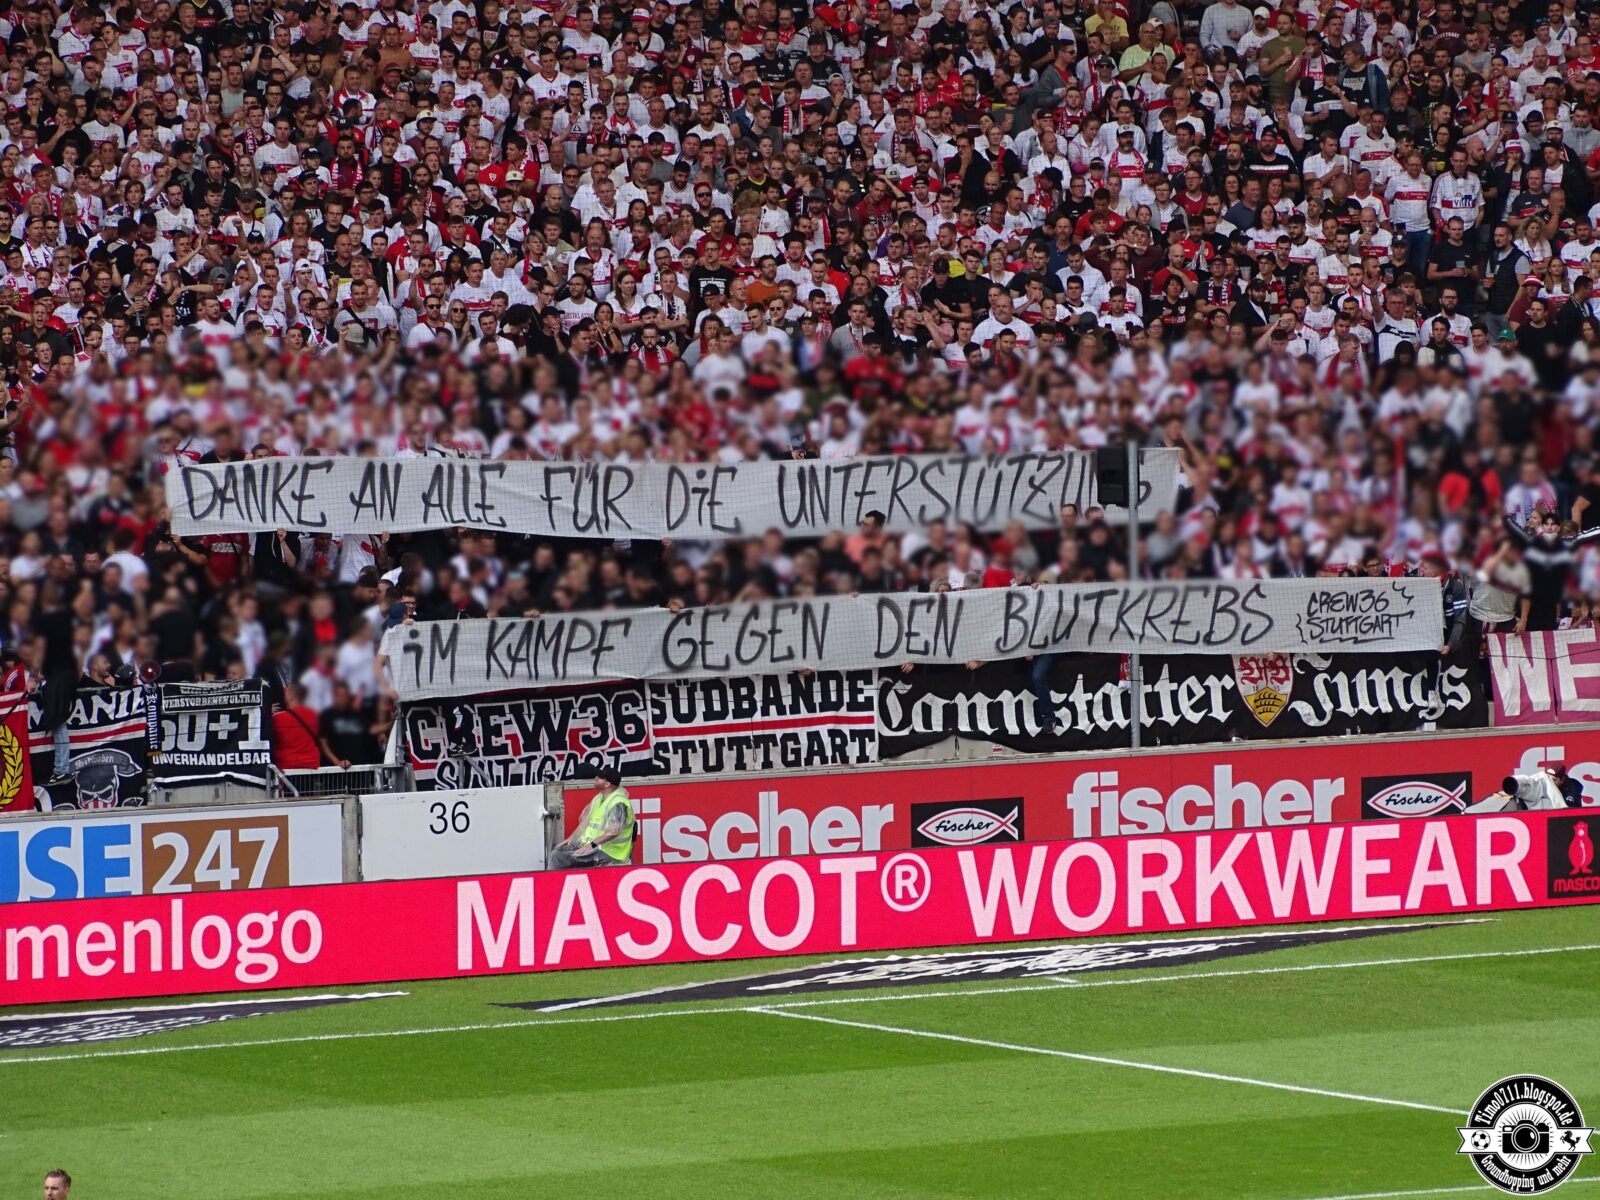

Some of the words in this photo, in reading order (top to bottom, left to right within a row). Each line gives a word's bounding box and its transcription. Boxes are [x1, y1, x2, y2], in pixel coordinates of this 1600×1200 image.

[182, 459, 335, 528] DANKE
[349, 461, 403, 524] AN
[421, 462, 507, 528] ALLE
[539, 462, 634, 533] FÜR
[777, 449, 1152, 530] UNTERSTÜTZUN
[485, 617, 634, 681] KAMPF
[661, 602, 831, 673] GEGEN
[873, 596, 965, 660] DEN
[995, 583, 1275, 655] BLUTKREBS
[229, 693, 261, 705] ULTRAS
[650, 669, 875, 725] SÜDBANDE
[152, 751, 271, 766] UNVERHANDELBAR
[651, 728, 876, 775] STUTTGART
[428, 801, 471, 836] 36
[934, 818, 995, 834] fischer
[1066, 764, 1346, 838] fischer
[1384, 792, 1443, 807] fischer
[152, 825, 279, 894] 247
[958, 816, 1535, 938] WORKWEAR
[0, 898, 323, 984] menlogo
